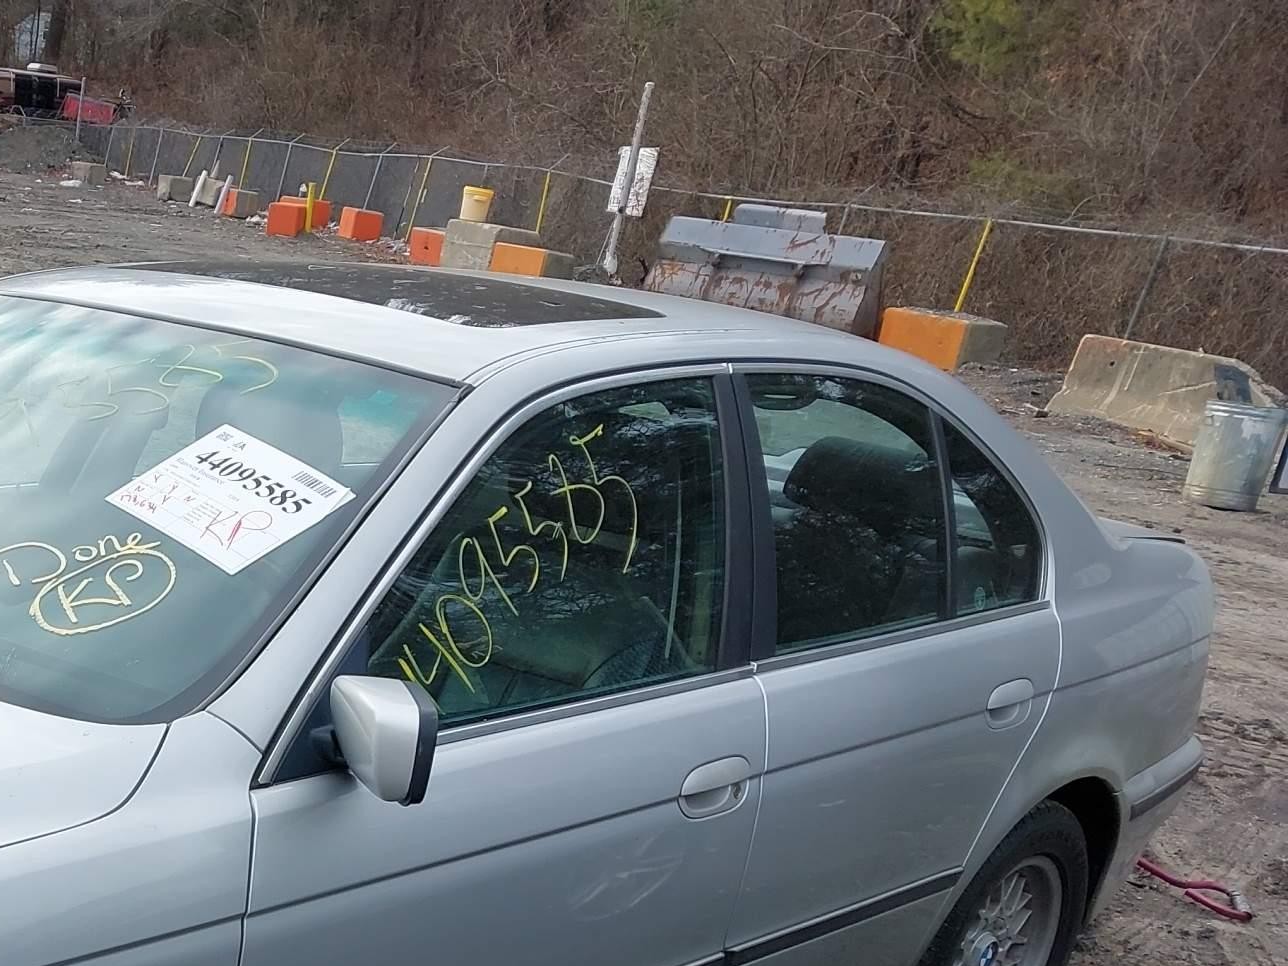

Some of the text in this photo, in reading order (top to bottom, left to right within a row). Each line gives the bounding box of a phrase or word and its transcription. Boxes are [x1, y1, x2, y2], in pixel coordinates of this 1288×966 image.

[196, 449, 313, 515] 44095585
[201, 510, 273, 550] KP
[398, 423, 638, 694] 4095585
